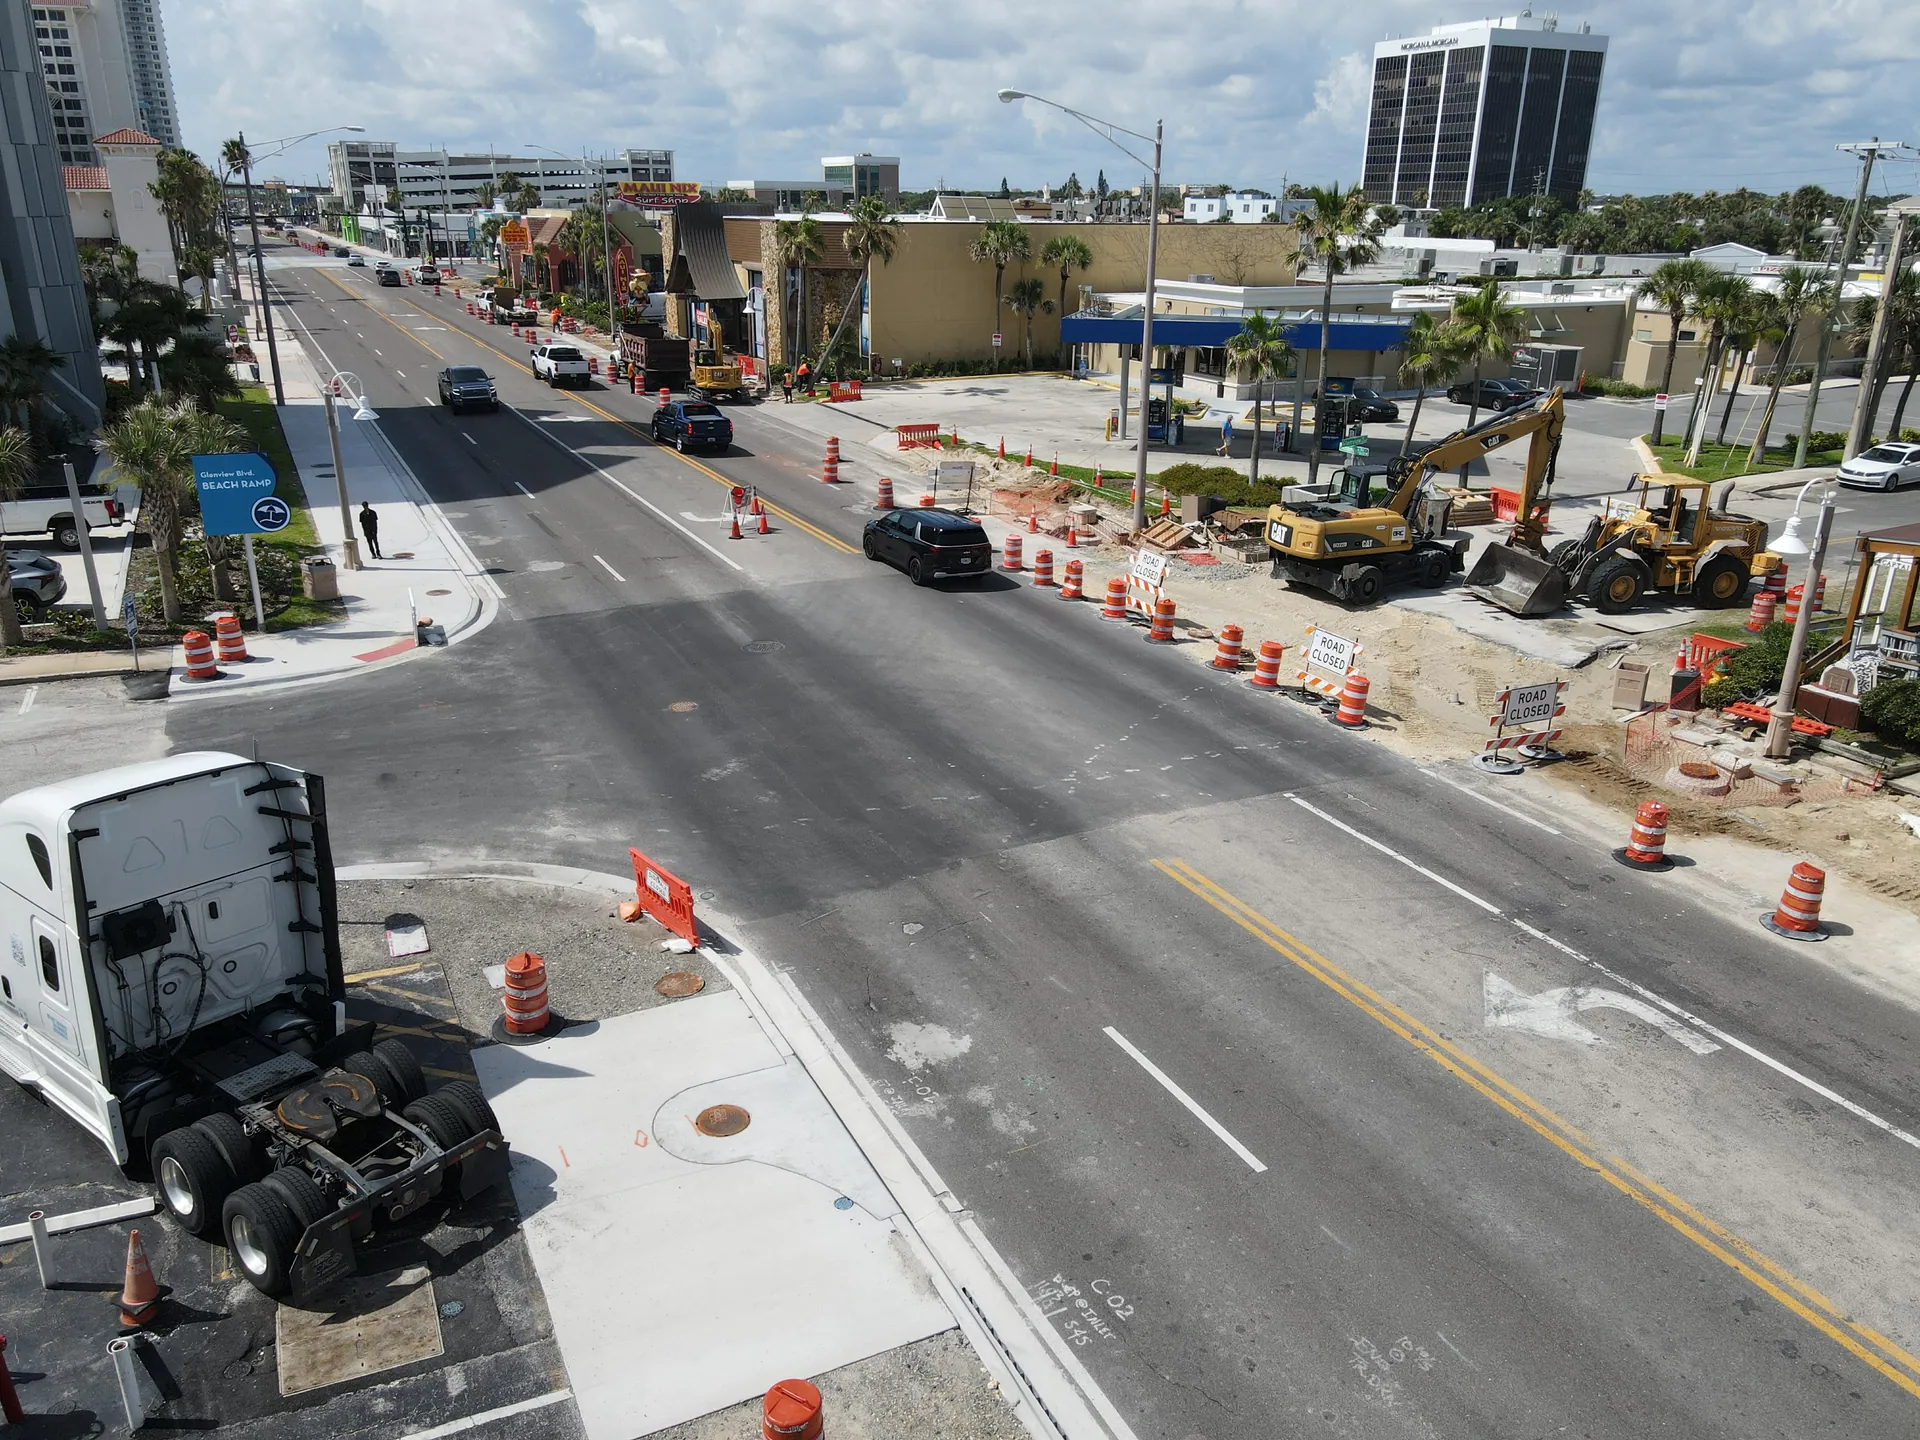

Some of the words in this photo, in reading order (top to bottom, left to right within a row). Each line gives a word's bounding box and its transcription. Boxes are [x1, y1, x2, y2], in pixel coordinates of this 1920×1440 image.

[1401, 42, 1425, 50] MORGAN
[1431, 38, 1459, 47] MORGAN
[624, 183, 666, 193] MAUI
[670, 183, 698, 193] NIX
[1488, 435, 1500, 446] CAT
[200, 471, 235, 479] Glenview
[236, 469, 255, 477] Blvd.
[202, 480, 239, 490] BEACH
[241, 479, 272, 488] RAMP
[1271, 522, 1288, 544] CAT
[1361, 539, 1373, 548] CAT
[1143, 554, 1160, 568] ROAD
[1135, 564, 1159, 581] CLOSED
[1320, 636, 1345, 654] ROAD
[1312, 648, 1346, 670] CLOSED
[1518, 689, 1547, 704] ROAD
[1510, 703, 1550, 720] CLOSED
